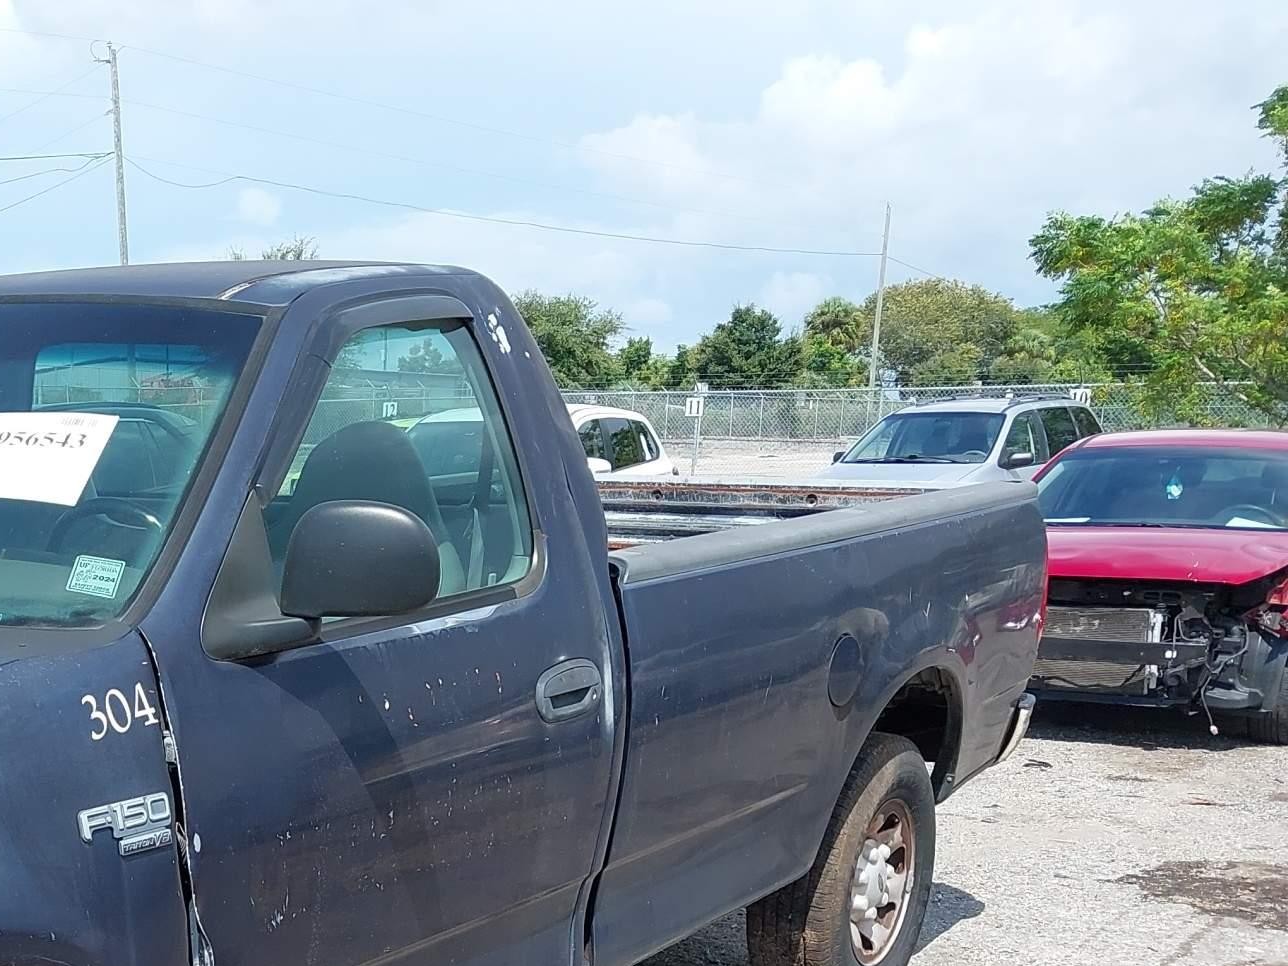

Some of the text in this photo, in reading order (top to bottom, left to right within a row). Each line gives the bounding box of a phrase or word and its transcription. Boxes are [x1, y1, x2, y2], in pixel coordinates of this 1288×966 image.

[689, 400, 700, 415] 11
[92, 574, 116, 583] 2024
[81, 682, 159, 741] 304
[77, 791, 172, 844] F-150
